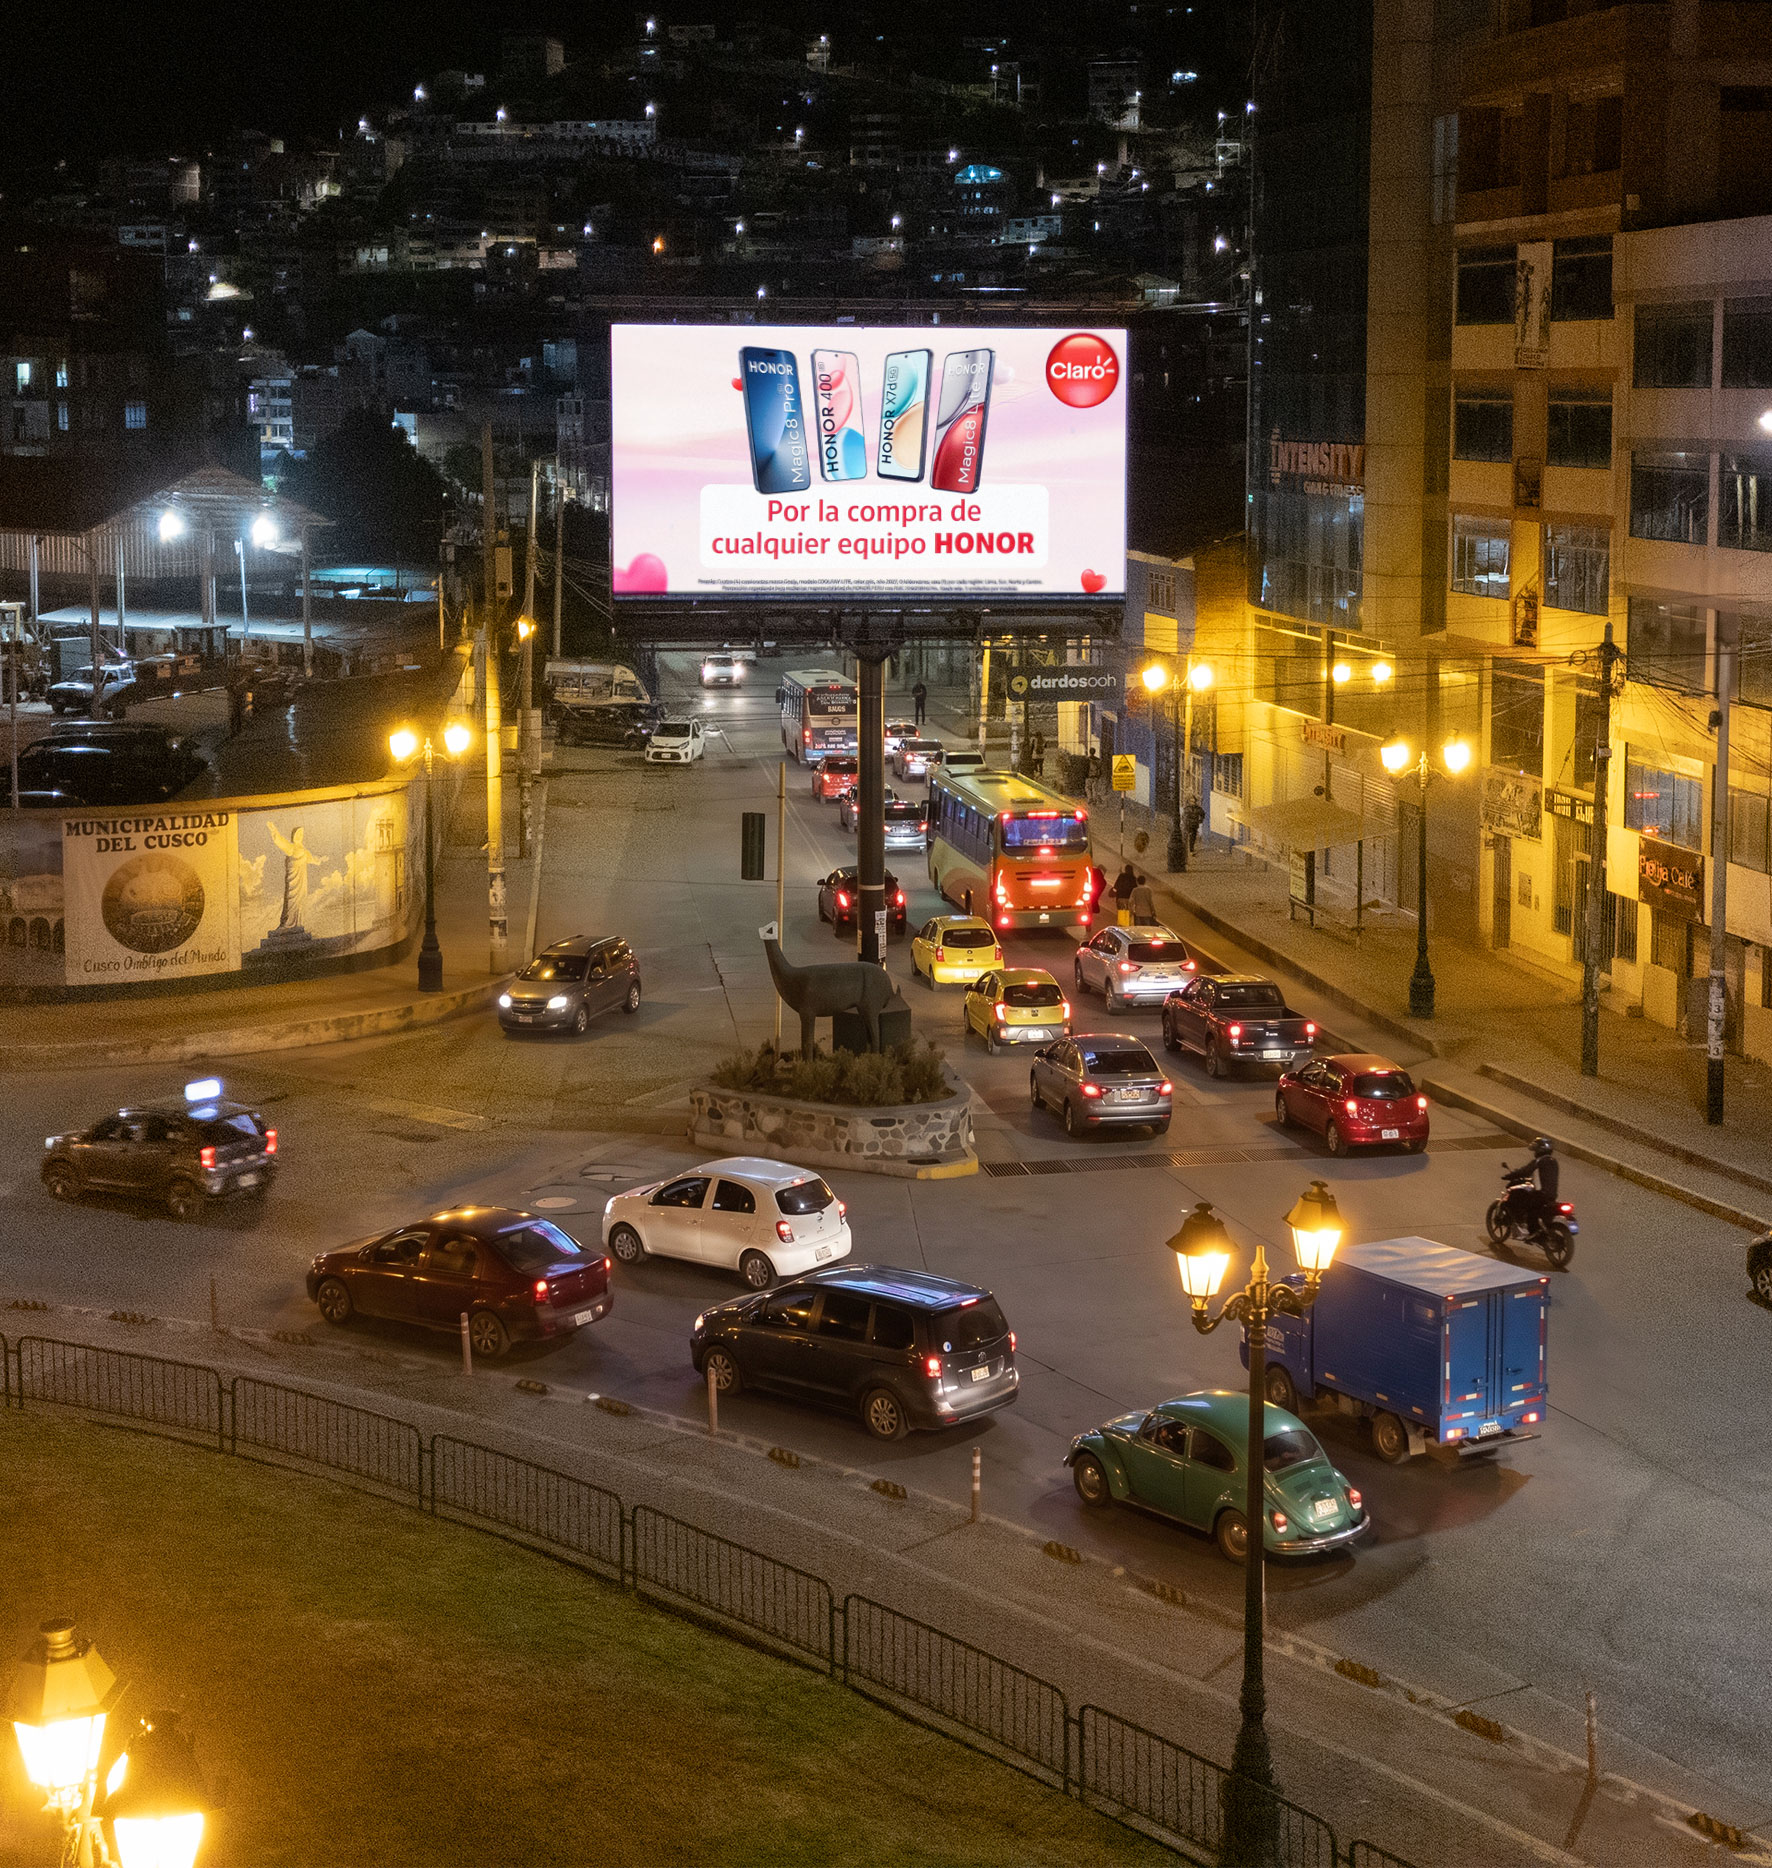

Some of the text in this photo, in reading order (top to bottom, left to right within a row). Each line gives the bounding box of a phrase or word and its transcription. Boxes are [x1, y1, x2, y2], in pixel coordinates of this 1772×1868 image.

[748, 360, 794, 376] HONOR
[948, 362, 985, 376] HONOR
[1050, 361, 1105, 380] Claro
[818, 373, 833, 401] 400
[885, 382, 898, 405] X7d
[783, 383, 805, 483] Magic8 Pro
[822, 407, 839, 473] HONOR
[881, 409, 895, 464] HONOR
[958, 381, 981, 484] Magic8 Lite
[1270, 438, 1365, 480] INTENSITY
[767, 498, 982, 528] Por la compra de
[711, 531, 1035, 560] cualquier equipo HONOR
[1030, 673, 1117, 689] dardosooh
[65, 811, 229, 837] MUNICIPALIDAD
[96, 832, 208, 853] DEL CUSCO
[83, 946, 227, 973] Cusco Ombligo del Mundo
